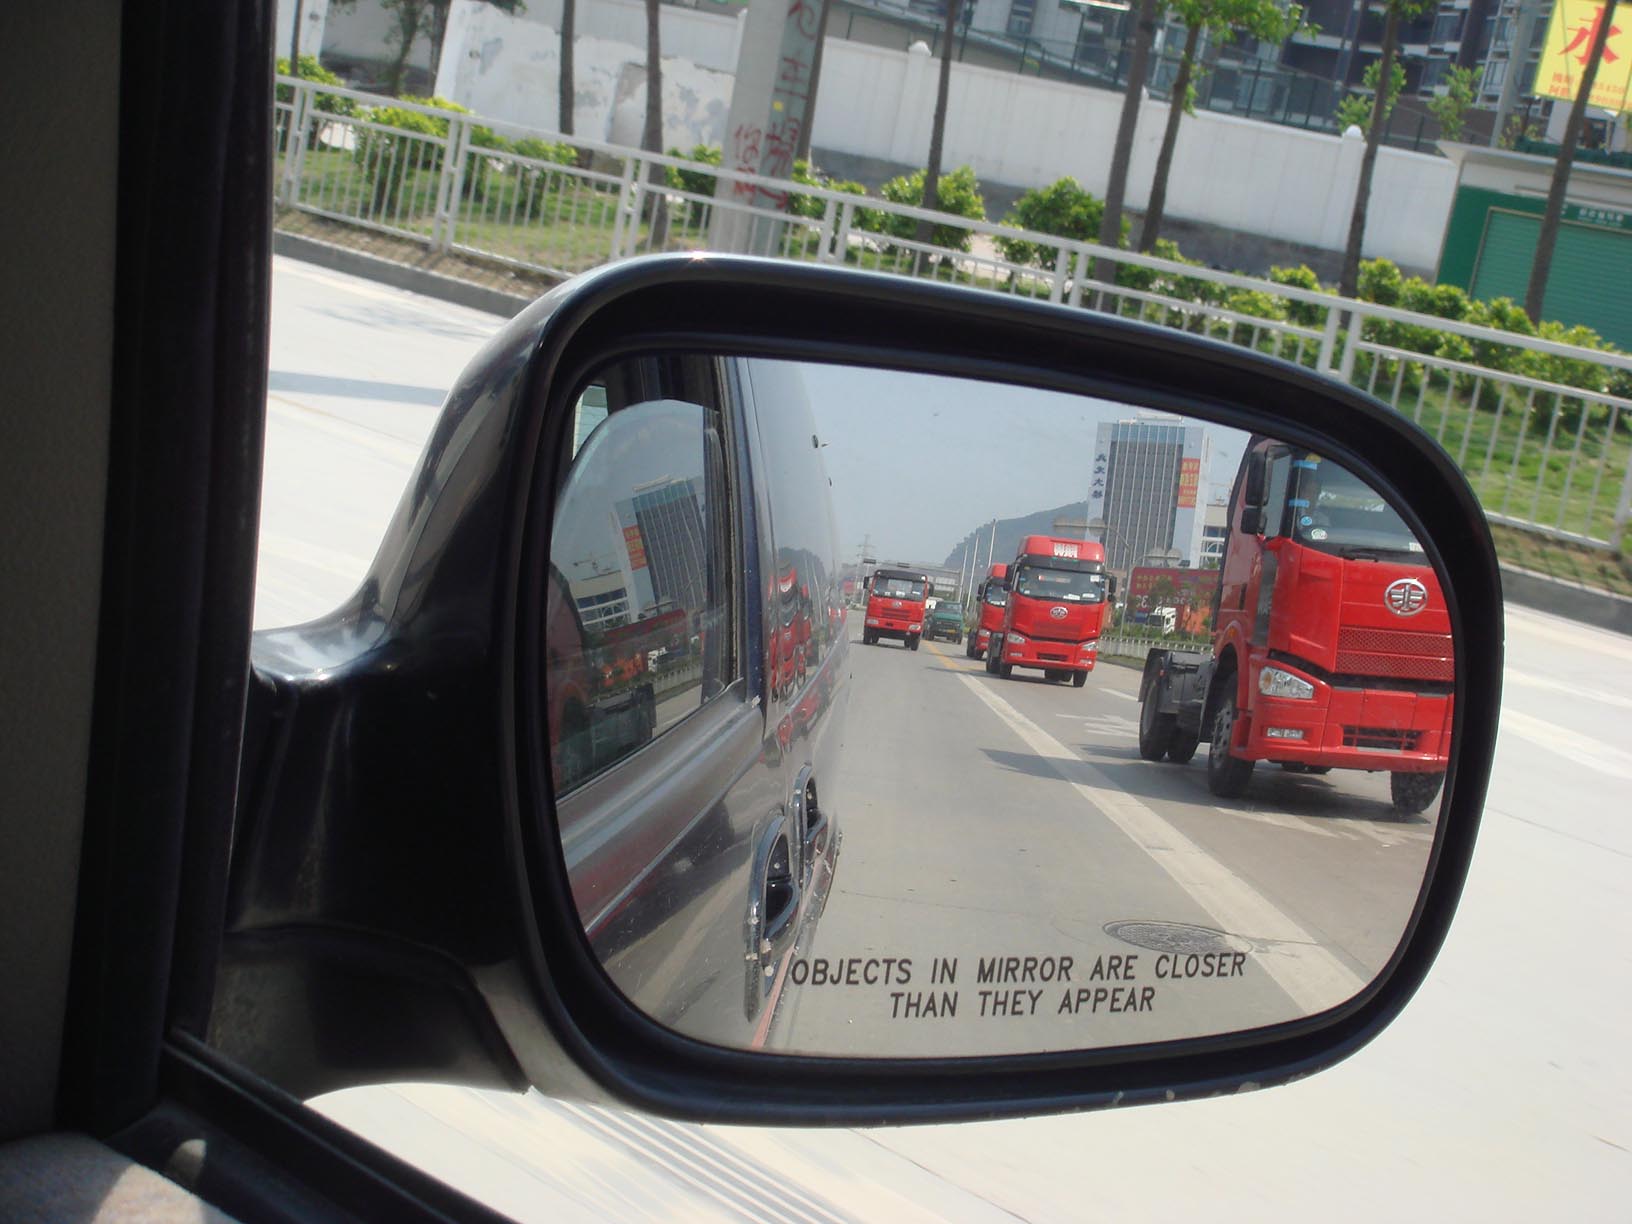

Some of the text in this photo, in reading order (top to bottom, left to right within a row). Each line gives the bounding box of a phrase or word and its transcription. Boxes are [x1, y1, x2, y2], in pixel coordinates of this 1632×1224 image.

[791, 951, 1246, 986] OBJECTS IN MIRROR ARE CLOSER
[890, 986, 1156, 1019] THAN THEY APPEAR
